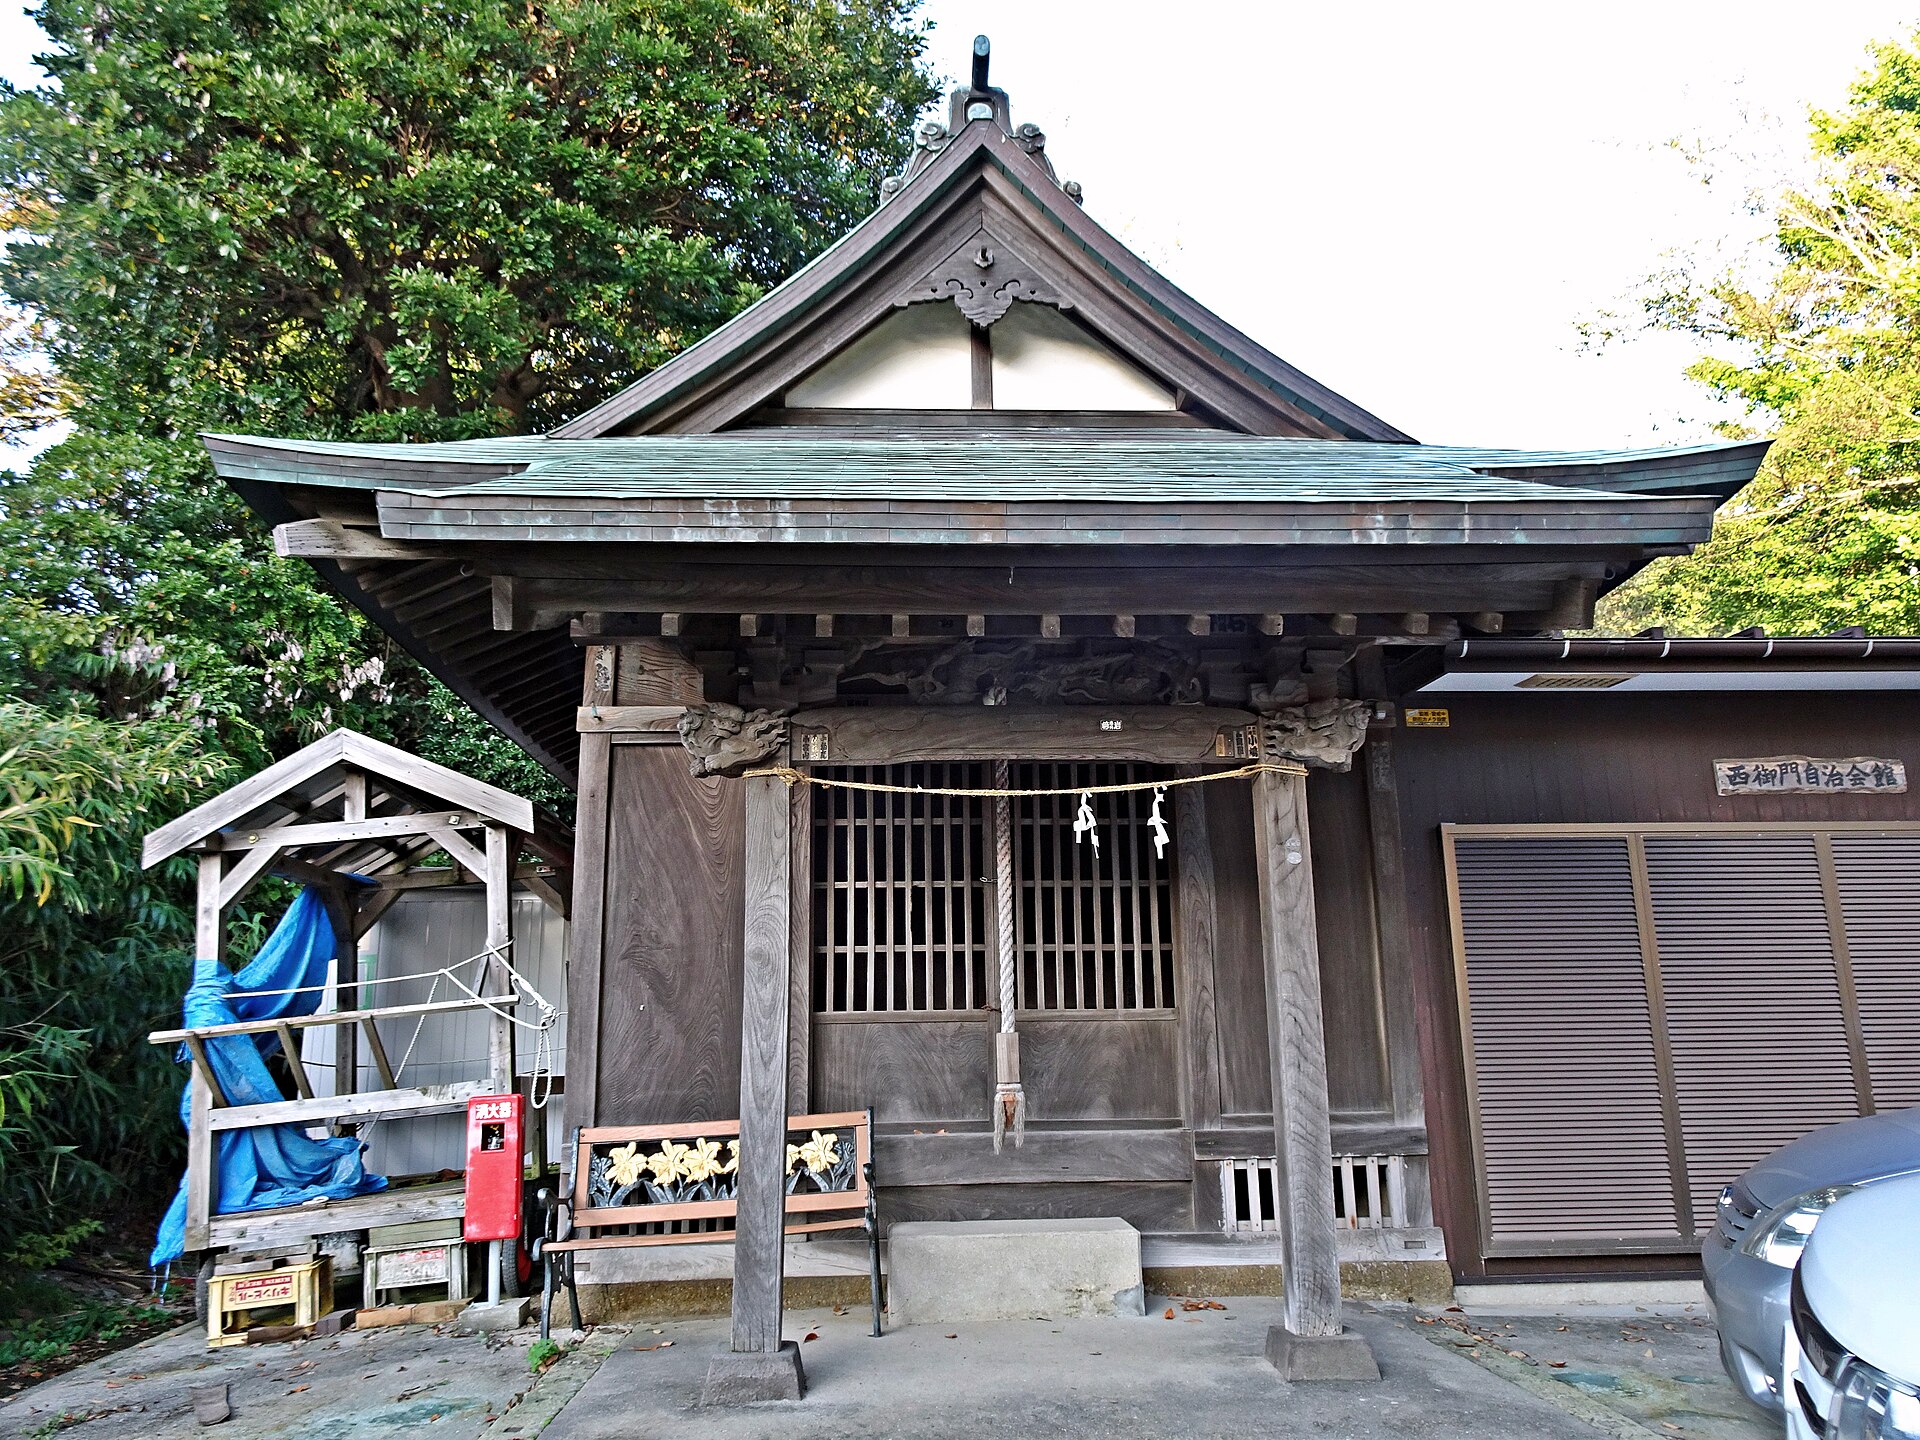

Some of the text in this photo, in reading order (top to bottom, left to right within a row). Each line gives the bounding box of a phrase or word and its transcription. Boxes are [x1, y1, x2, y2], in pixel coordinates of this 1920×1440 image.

[1725, 761, 1899, 788] 西御門自治会館
[475, 1101, 512, 1120] 消火器
[238, 1286, 290, 1301] キリンビール
